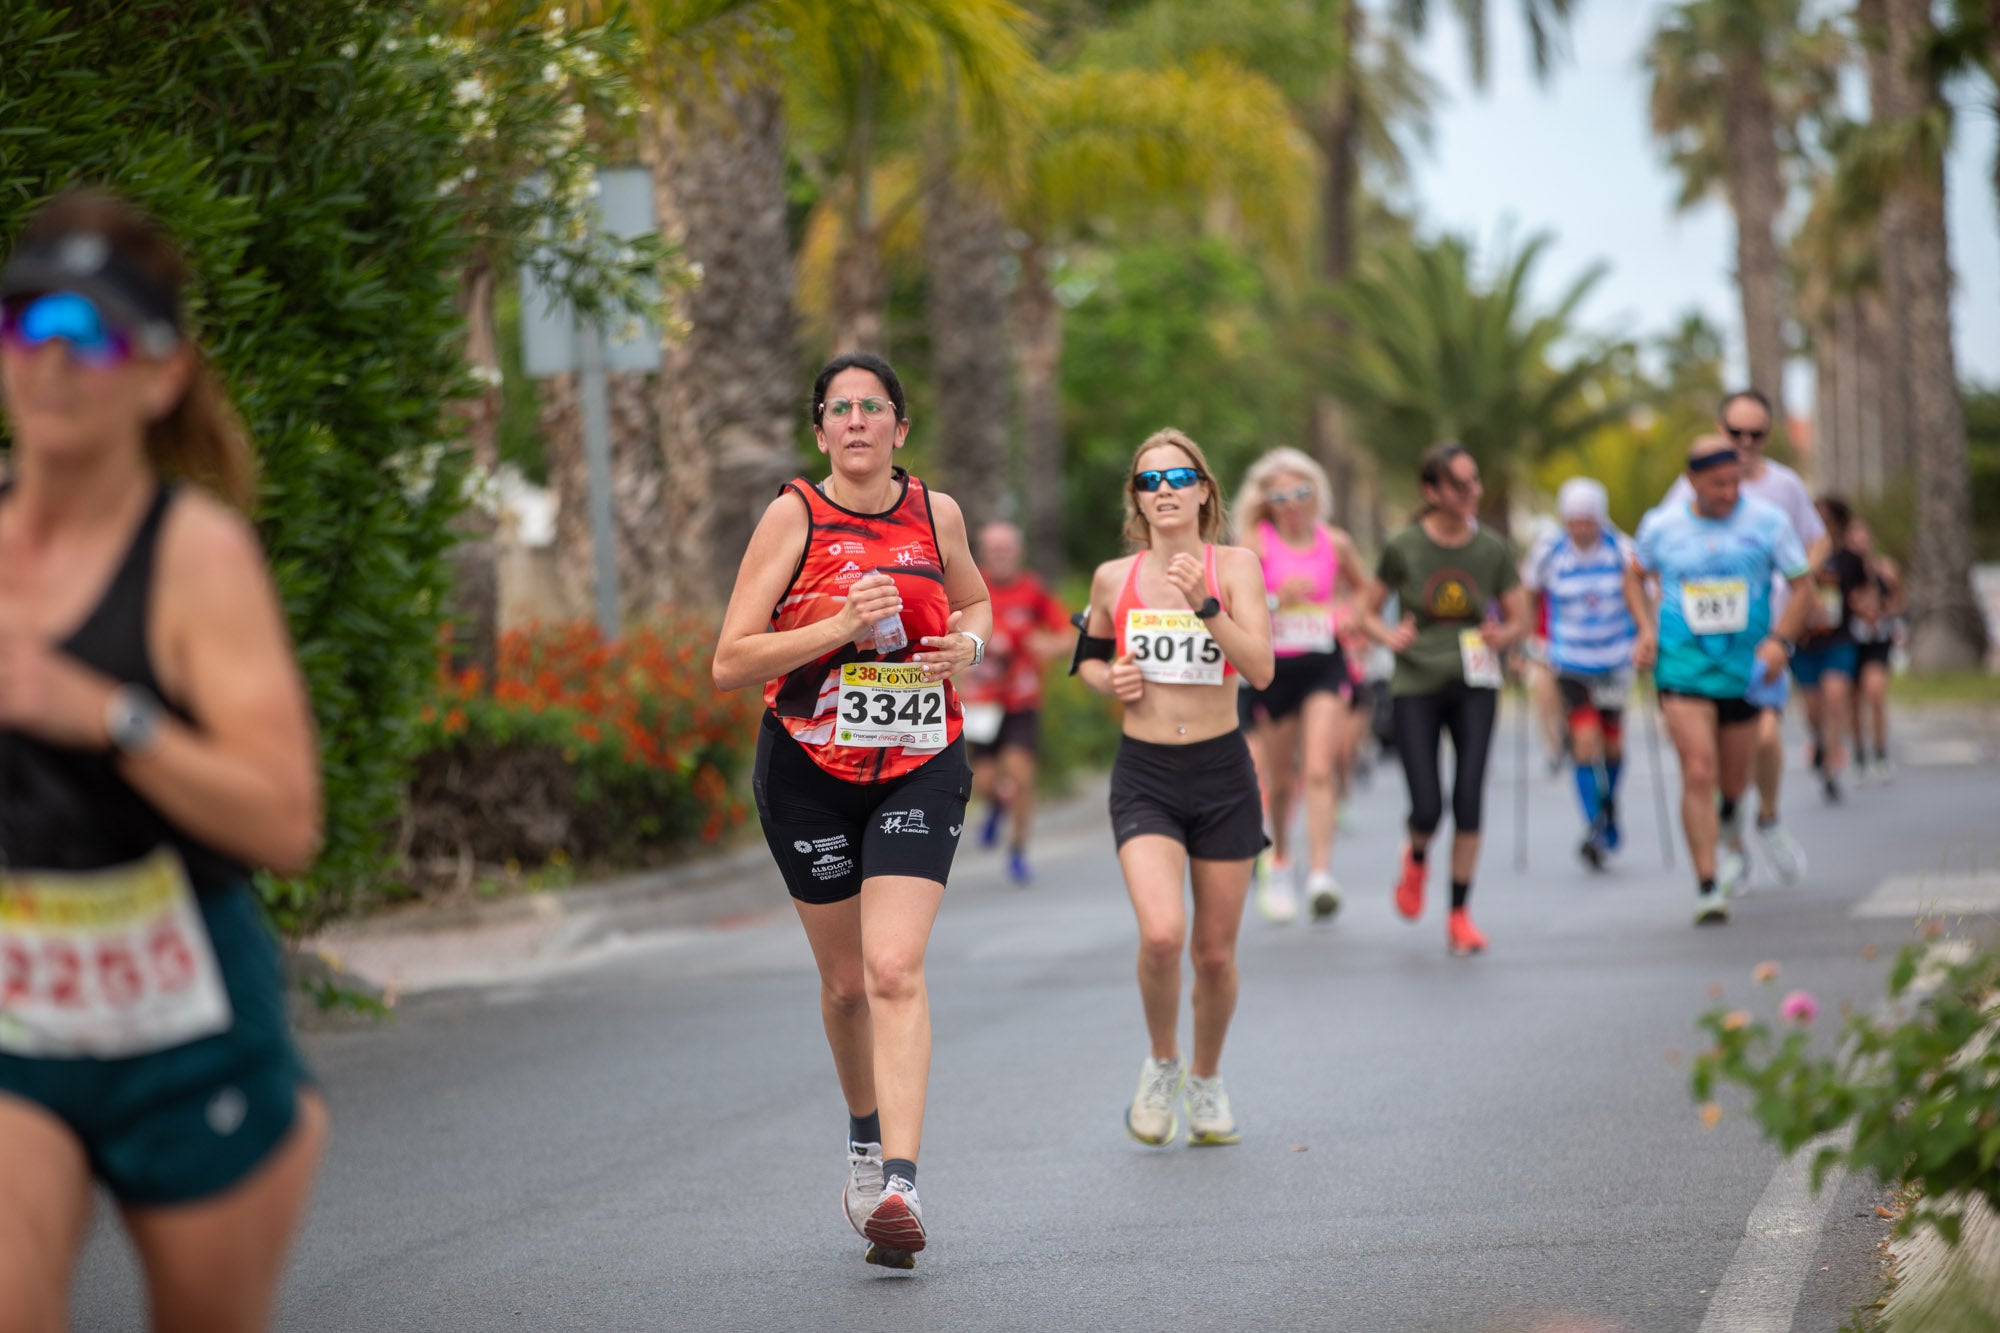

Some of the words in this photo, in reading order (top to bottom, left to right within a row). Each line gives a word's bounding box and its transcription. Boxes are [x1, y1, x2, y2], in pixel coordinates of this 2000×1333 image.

[834, 571, 863, 581] ALBOLOT
[1132, 635, 1221, 664] 3015
[858, 666, 877, 681] 38
[877, 672, 925, 684] FONDO
[842, 690, 942, 726] 3342
[811, 859, 853, 873] ALBOLOTE
[819, 869, 851, 881] DEPORTES
